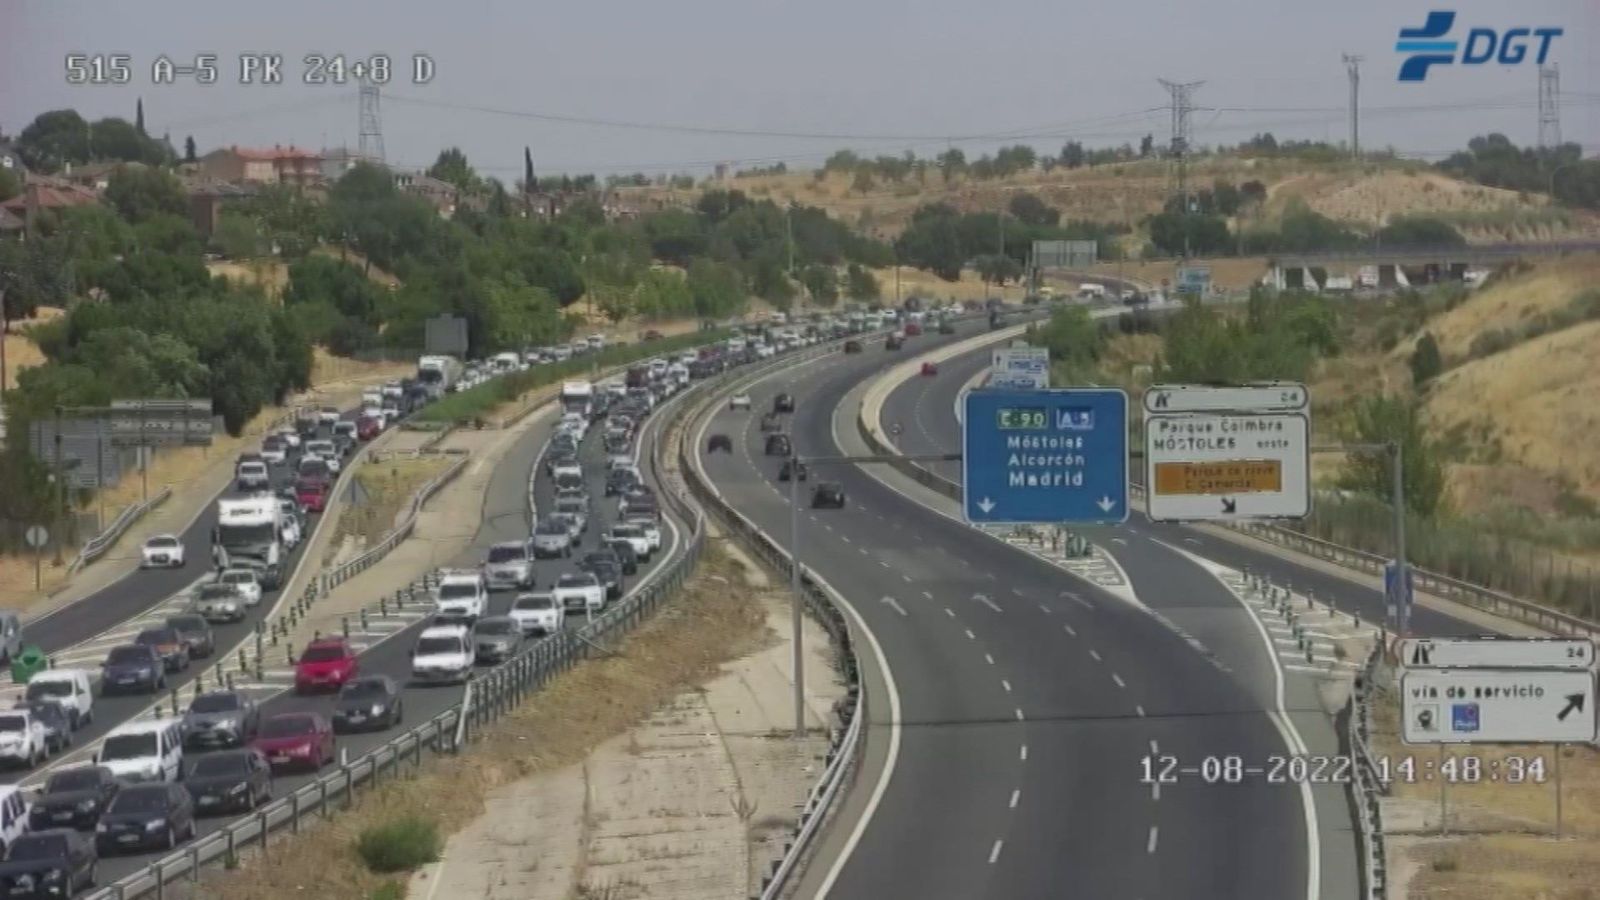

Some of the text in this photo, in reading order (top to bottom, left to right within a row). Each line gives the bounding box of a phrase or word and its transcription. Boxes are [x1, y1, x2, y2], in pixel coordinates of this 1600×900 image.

[1159, 418, 1283, 433] Parque Coimbra
[1007, 434, 1084, 449] Móstoles
[1154, 434, 1236, 450] MÓSTOLES
[1007, 452, 1085, 467] Alcorcón
[1008, 471, 1083, 486] Madrid
[1567, 647, 1585, 658] 24
[1446, 684, 1466, 698] de
[1474, 683, 1545, 698] servicio
